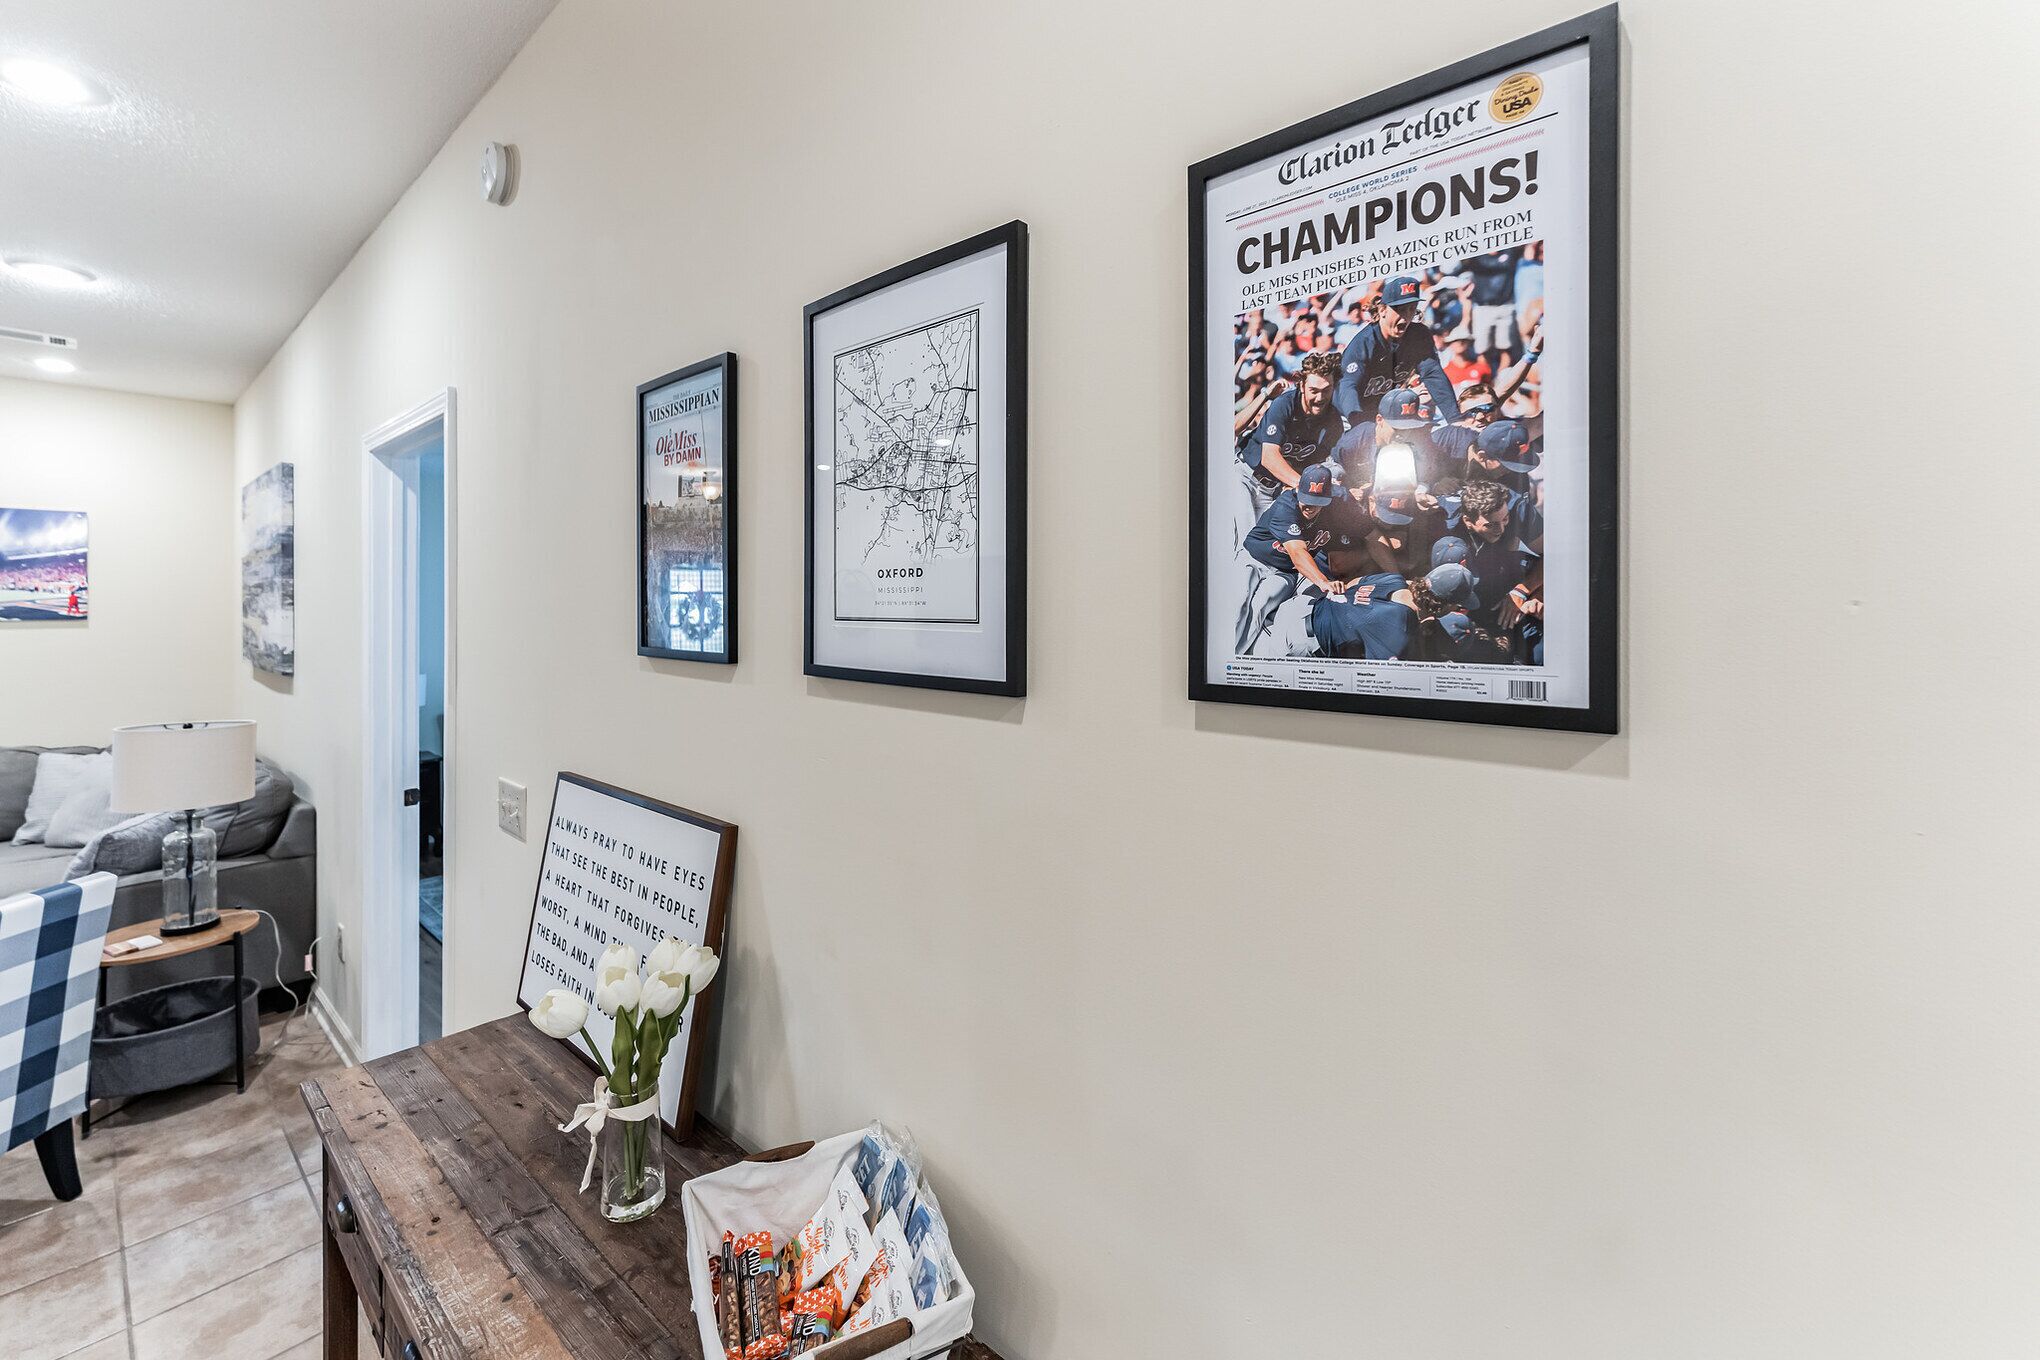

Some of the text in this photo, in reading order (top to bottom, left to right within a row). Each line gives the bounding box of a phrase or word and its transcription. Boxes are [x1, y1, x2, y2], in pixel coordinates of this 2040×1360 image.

[1503, 97, 1532, 113] USA
[1278, 100, 1480, 185] Clarion Ledger
[1328, 166, 1418, 199] COLLEGE WORLD SERIES
[1369, 178, 1404, 192] OKLAHOMA
[1237, 150, 1538, 275] CHAMPIONS!
[1242, 209, 1532, 296] OLE MISS FINISHES AMAZING RUN FROM
[1242, 226, 1534, 310] LAST TEAM PICKED TO FIRST CWS TITLE
[649, 388, 720, 423] MISSISSIPPIAN
[656, 430, 697, 455] Ole Miss
[664, 447, 701, 466] BY DAMN
[877, 568, 923, 578] OXFORD
[555, 816, 706, 891] ALWAYS PRAY TO HAVE EYES
[545, 869, 551, 882] A
[554, 874, 582, 898] HEART
[587, 890, 610, 913] THAT
[614, 906, 665, 943] FORGIVES
[551, 842, 699, 929] THAT SEE THE BEST IN PEOPLE,
[542, 895, 569, 925] WORST,
[573, 915, 579, 929] A
[583, 921, 607, 945] MIND
[536, 922, 595, 972] THE BAD, AND A
[531, 950, 594, 1005] LOSES FAITH IN
[748, 1246, 761, 1276] KIND
